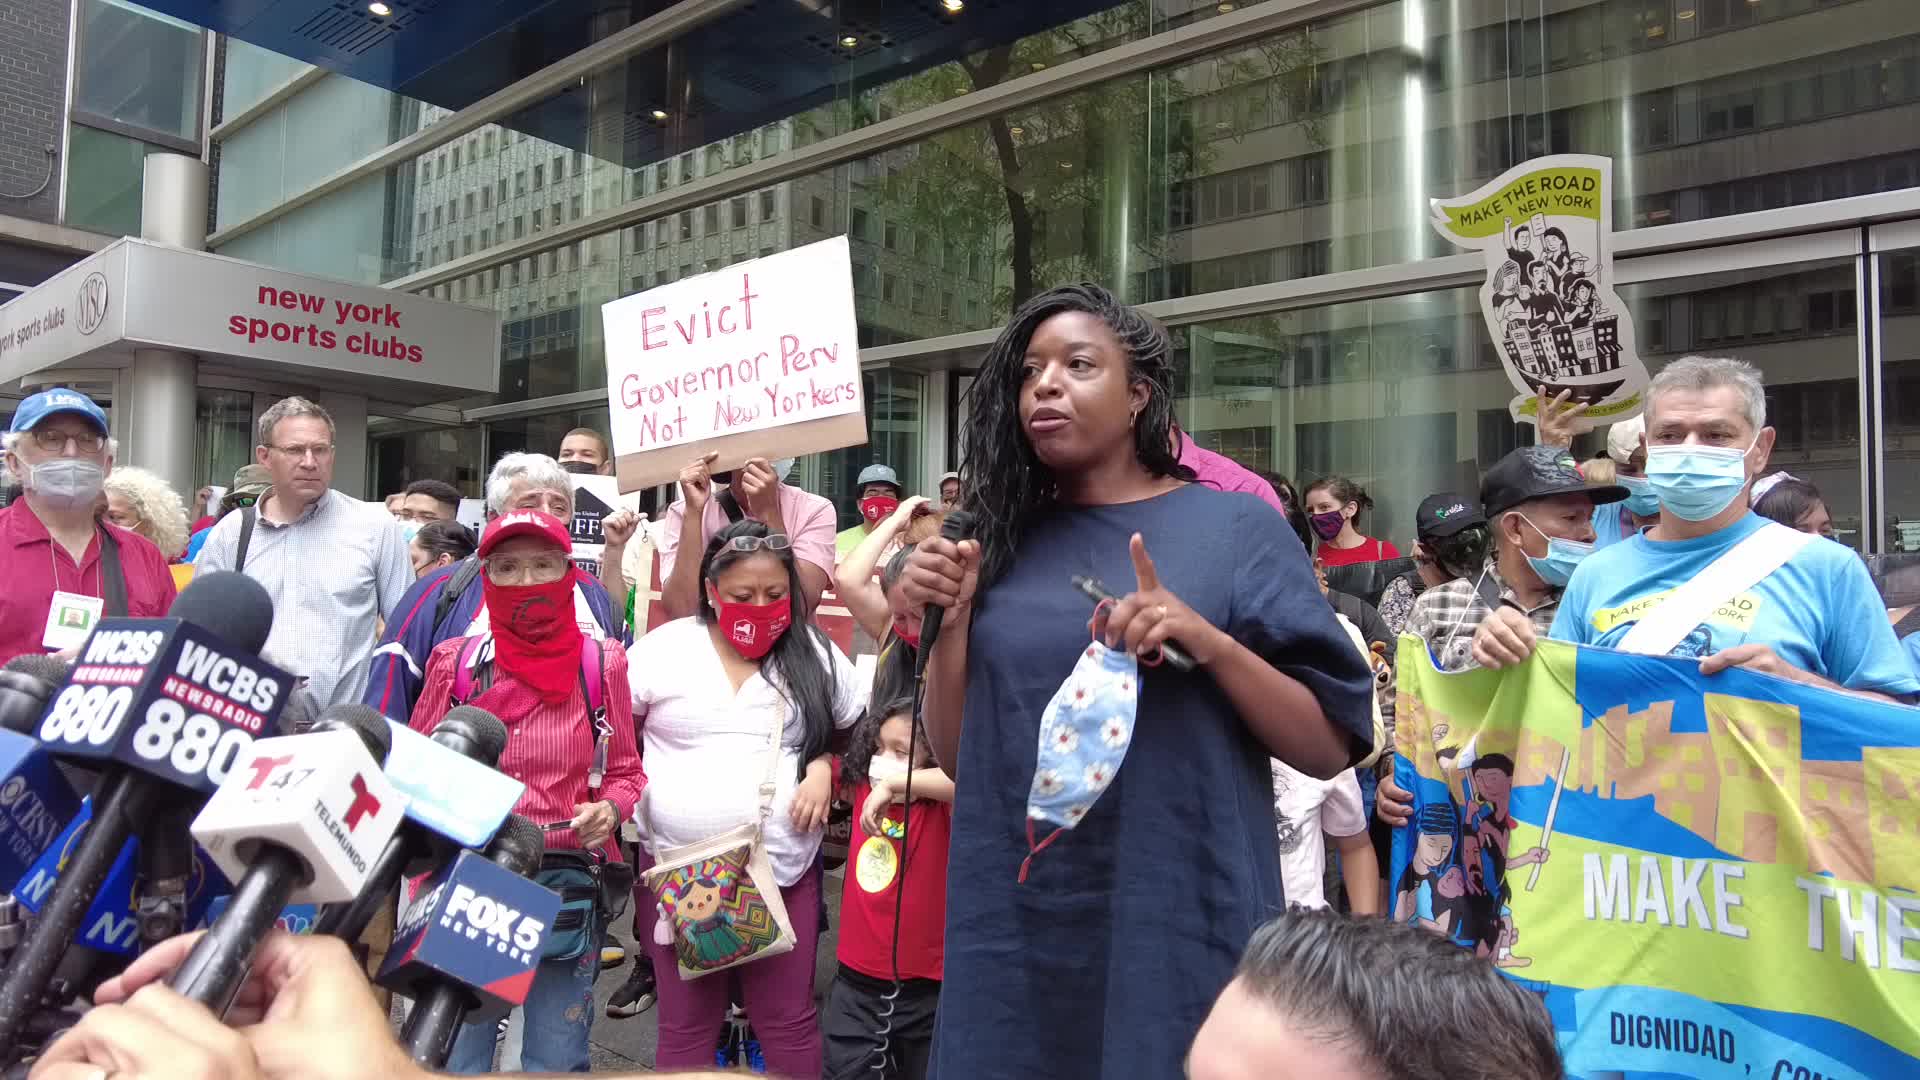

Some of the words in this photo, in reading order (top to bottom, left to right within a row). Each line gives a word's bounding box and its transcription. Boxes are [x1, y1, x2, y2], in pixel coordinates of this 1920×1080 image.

[1460, 202, 1503, 226] MAKE
[1503, 180, 1537, 206] THE
[1541, 175, 1595, 192] ROAD
[1518, 197, 1549, 216] NEW
[1554, 194, 1593, 209] YORK
[17, 317, 41, 349] sports
[43, 306, 65, 332] clubs
[258, 285, 325, 314] new
[335, 299, 402, 329] york
[640, 273, 759, 350] Evict
[229, 314, 337, 349] sports
[346, 331, 424, 363] clubs
[620, 351, 769, 409] Governor
[780, 334, 838, 376] Perv
[640, 405, 688, 446] Not
[713, 395, 760, 431] New
[764, 378, 856, 417] Yorkers
[1610, 600, 1653, 623] MAKE
[1713, 607, 1749, 623] ORK
[1727, 596, 1753, 611] AD
[85, 630, 164, 665] WCBS
[73, 667, 145, 684] NEWSRADIO
[176, 639, 279, 713] WCBS
[40, 684, 133, 745] 880
[163, 677, 263, 731] NEWSRADIO
[133, 698, 255, 786] 880
[314, 799, 367, 874] TELEMUNDO
[445, 883, 521, 942] FOX
[514, 916, 545, 951] 5
[1583, 852, 1750, 939] MAKE
[1795, 875, 1920, 974] THE
[439, 914, 479, 940] NEW
[486, 935, 532, 965] YORK
